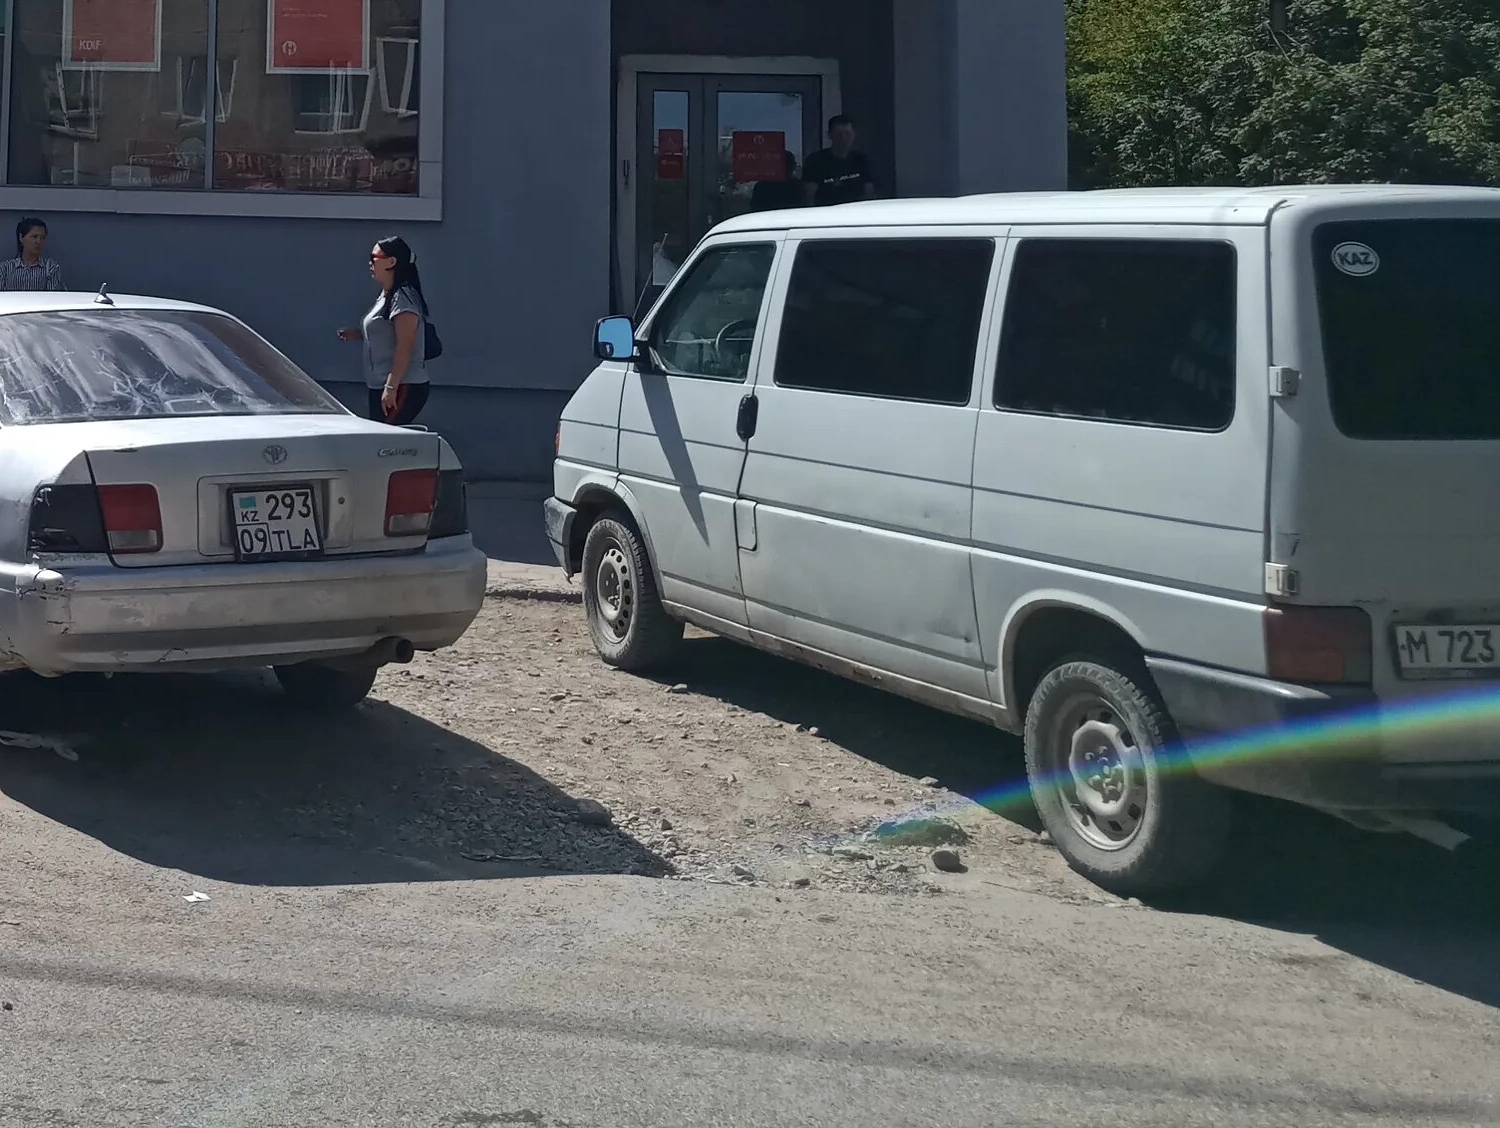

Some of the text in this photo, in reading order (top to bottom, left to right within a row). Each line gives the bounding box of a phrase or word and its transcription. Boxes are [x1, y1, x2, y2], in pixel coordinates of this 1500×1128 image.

[1337, 252, 1374, 266] KAZ
[265, 491, 312, 520] 293
[240, 510, 260, 522] KZ
[240, 527, 317, 553] 09 TLA
